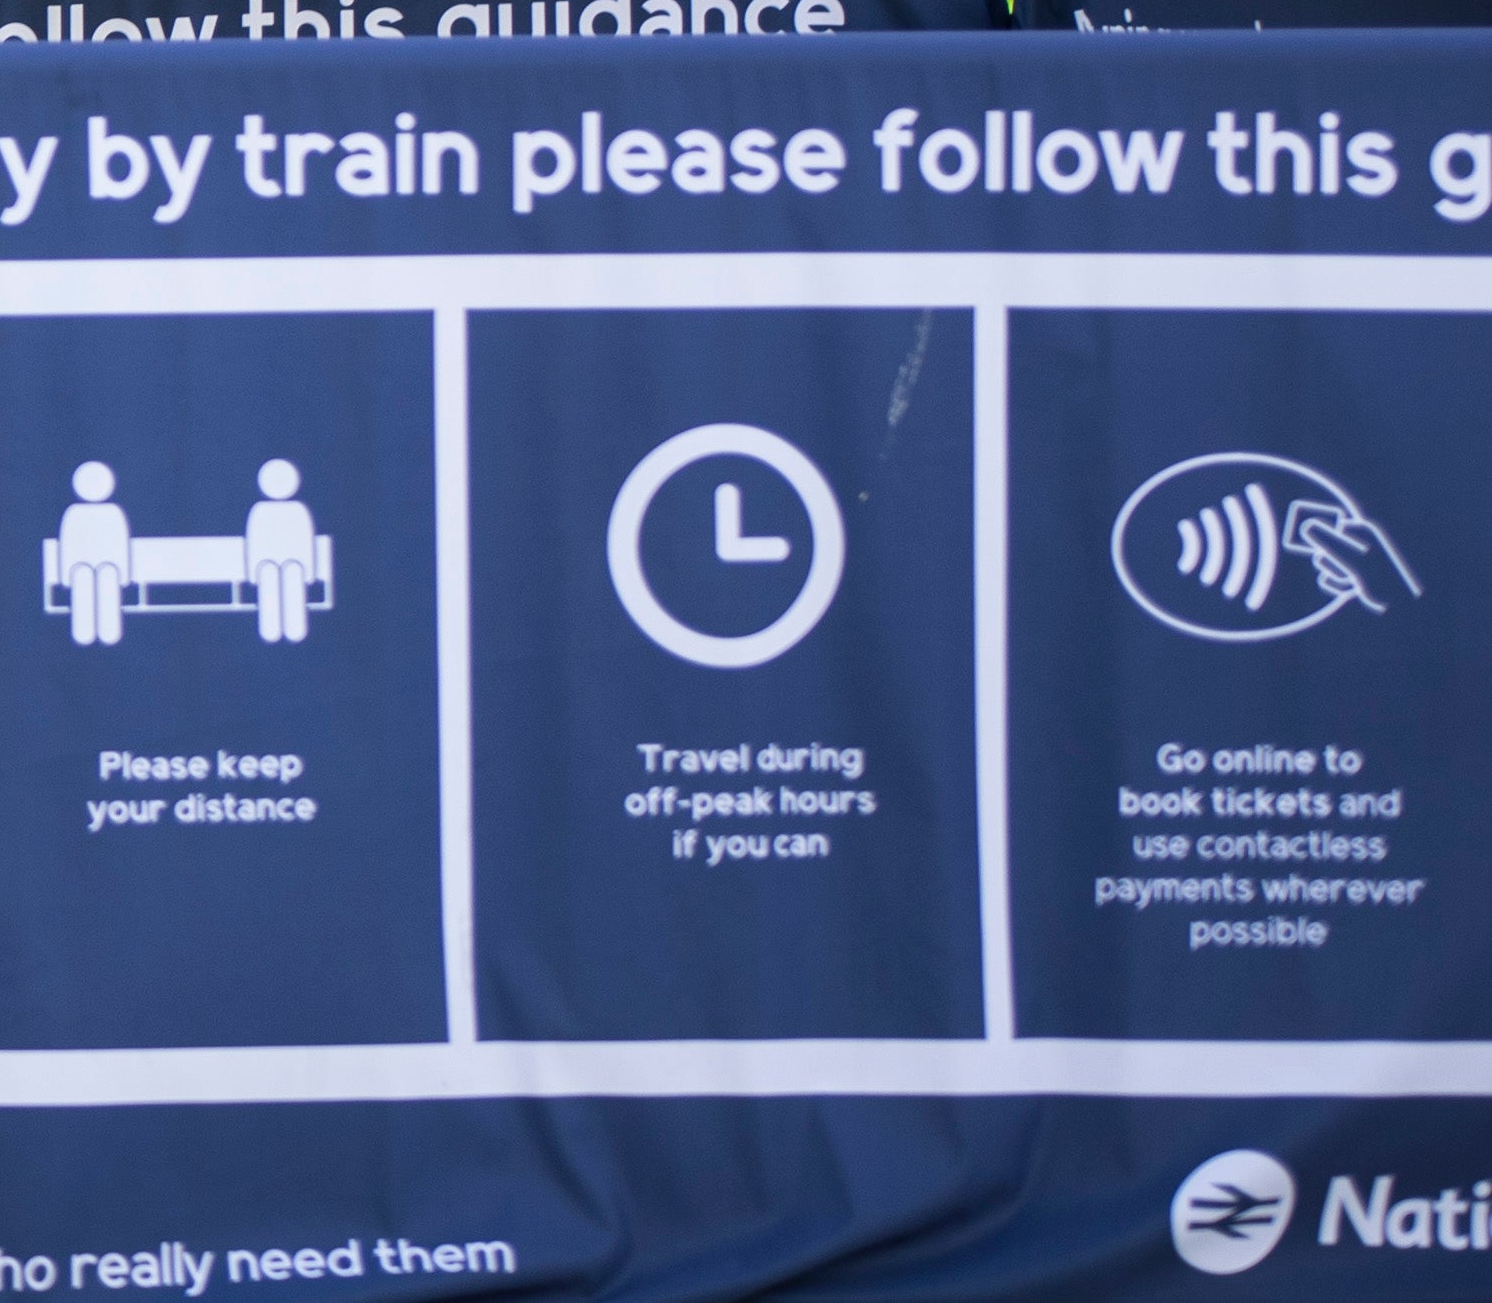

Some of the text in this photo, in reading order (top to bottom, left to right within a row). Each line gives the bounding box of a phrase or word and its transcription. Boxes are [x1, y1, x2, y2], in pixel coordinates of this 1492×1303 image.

[87, 115, 211, 224] by
[235, 110, 480, 198] train
[511, 109, 847, 214] please
[873, 106, 1185, 193] follow
[1207, 110, 1399, 197] this
[99, 748, 304, 785] Please keep
[636, 741, 866, 780] Travel during
[1156, 741, 1364, 776] Go online to
[85, 792, 318, 834] your distance
[623, 785, 879, 822] off-peak hours
[1118, 786, 1403, 819] book tickets and
[672, 828, 830, 867] if you can
[1132, 829, 1388, 862] use contactless
[1094, 872, 1426, 911] payments wherever
[1189, 915, 1329, 951] possible
[1317, 1173, 1492, 1252] Nati
[70, 1240, 215, 1297] really
[226, 1238, 364, 1284] need
[372, 1236, 519, 1276] them
